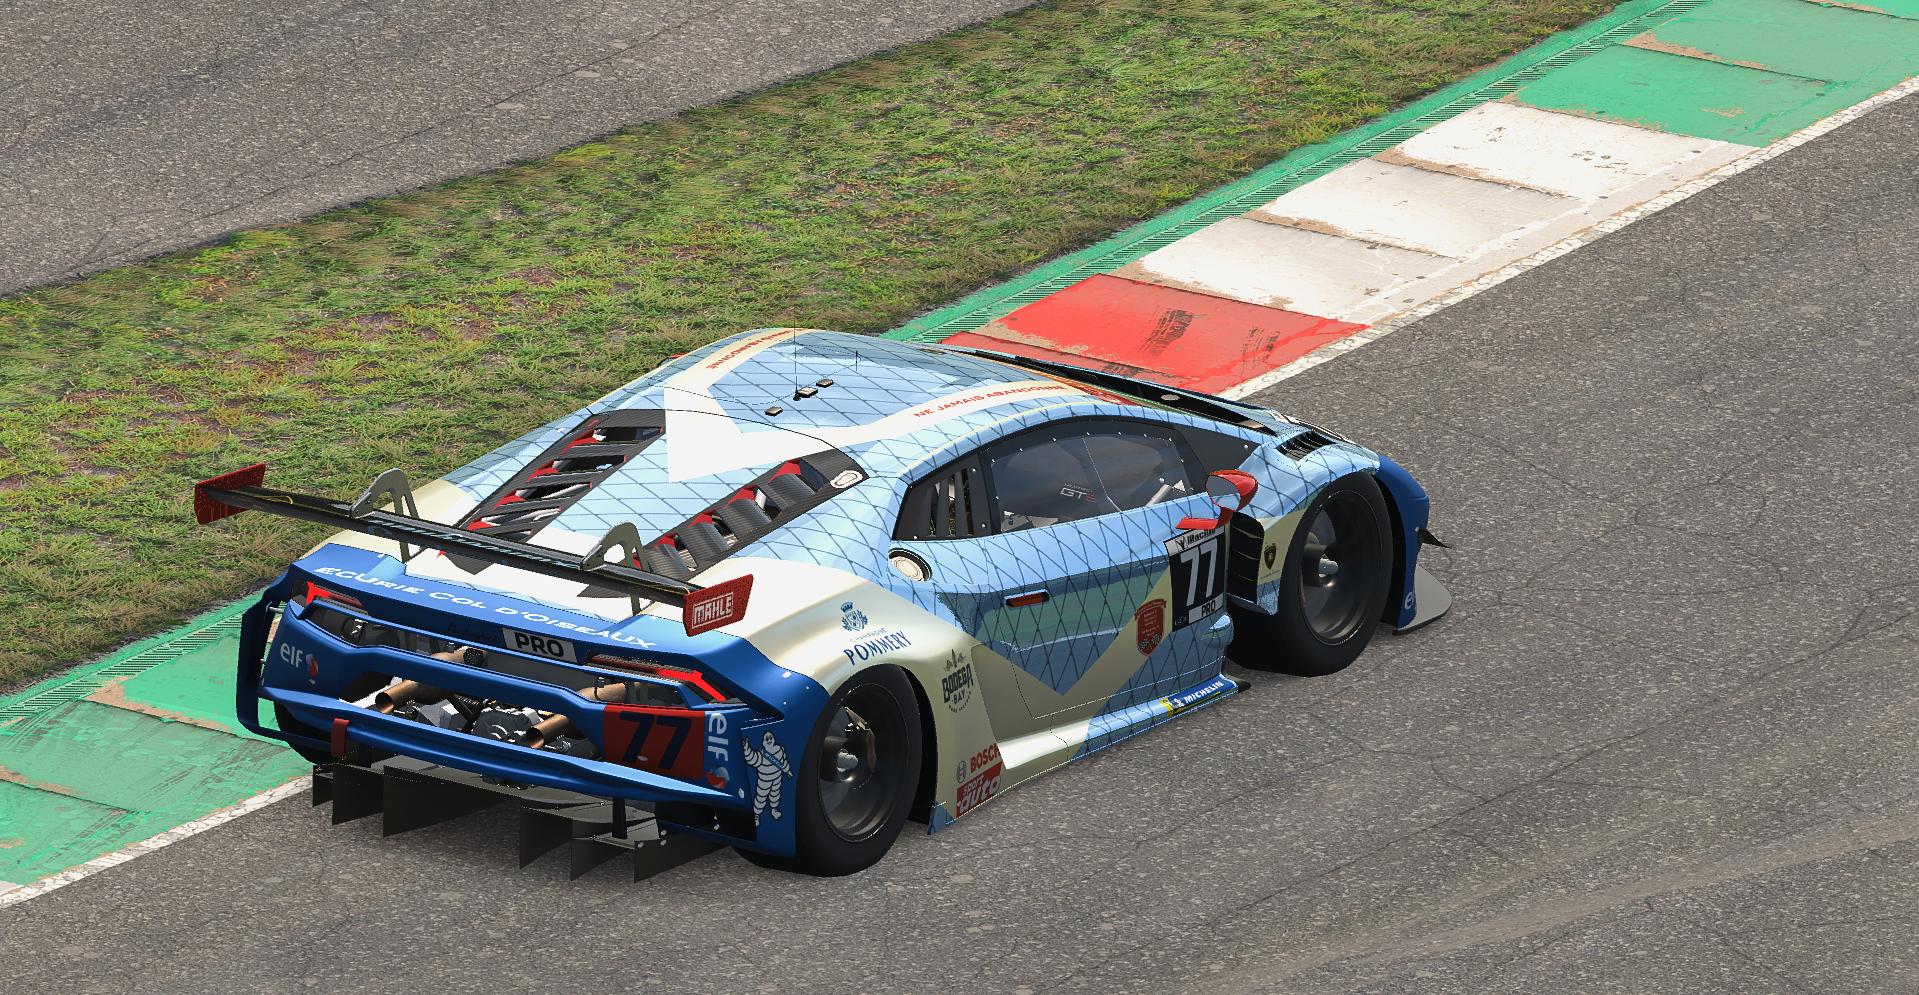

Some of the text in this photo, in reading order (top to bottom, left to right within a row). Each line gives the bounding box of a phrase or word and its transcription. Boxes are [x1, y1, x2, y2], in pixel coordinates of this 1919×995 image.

[913, 408, 935, 418] NE
[937, 394, 984, 411] JAMAIS
[1180, 537, 1218, 607] 77
[313, 566, 426, 596] ECURIE
[428, 591, 489, 610] COL
[494, 607, 657, 649] D'OISEAUX
[693, 594, 732, 626] MAHLE
[1201, 599, 1216, 618] PRO
[280, 642, 303, 668] elf
[514, 631, 565, 659] PRO
[843, 630, 912, 666] POMMERY
[941, 663, 974, 704] BODEGA
[953, 689, 966, 705] BAY
[1184, 680, 1225, 704] MICHELIN
[619, 710, 692, 770] 77
[707, 712, 729, 762] elf
[959, 775, 1001, 814] auto
[962, 774, 985, 797] sport
